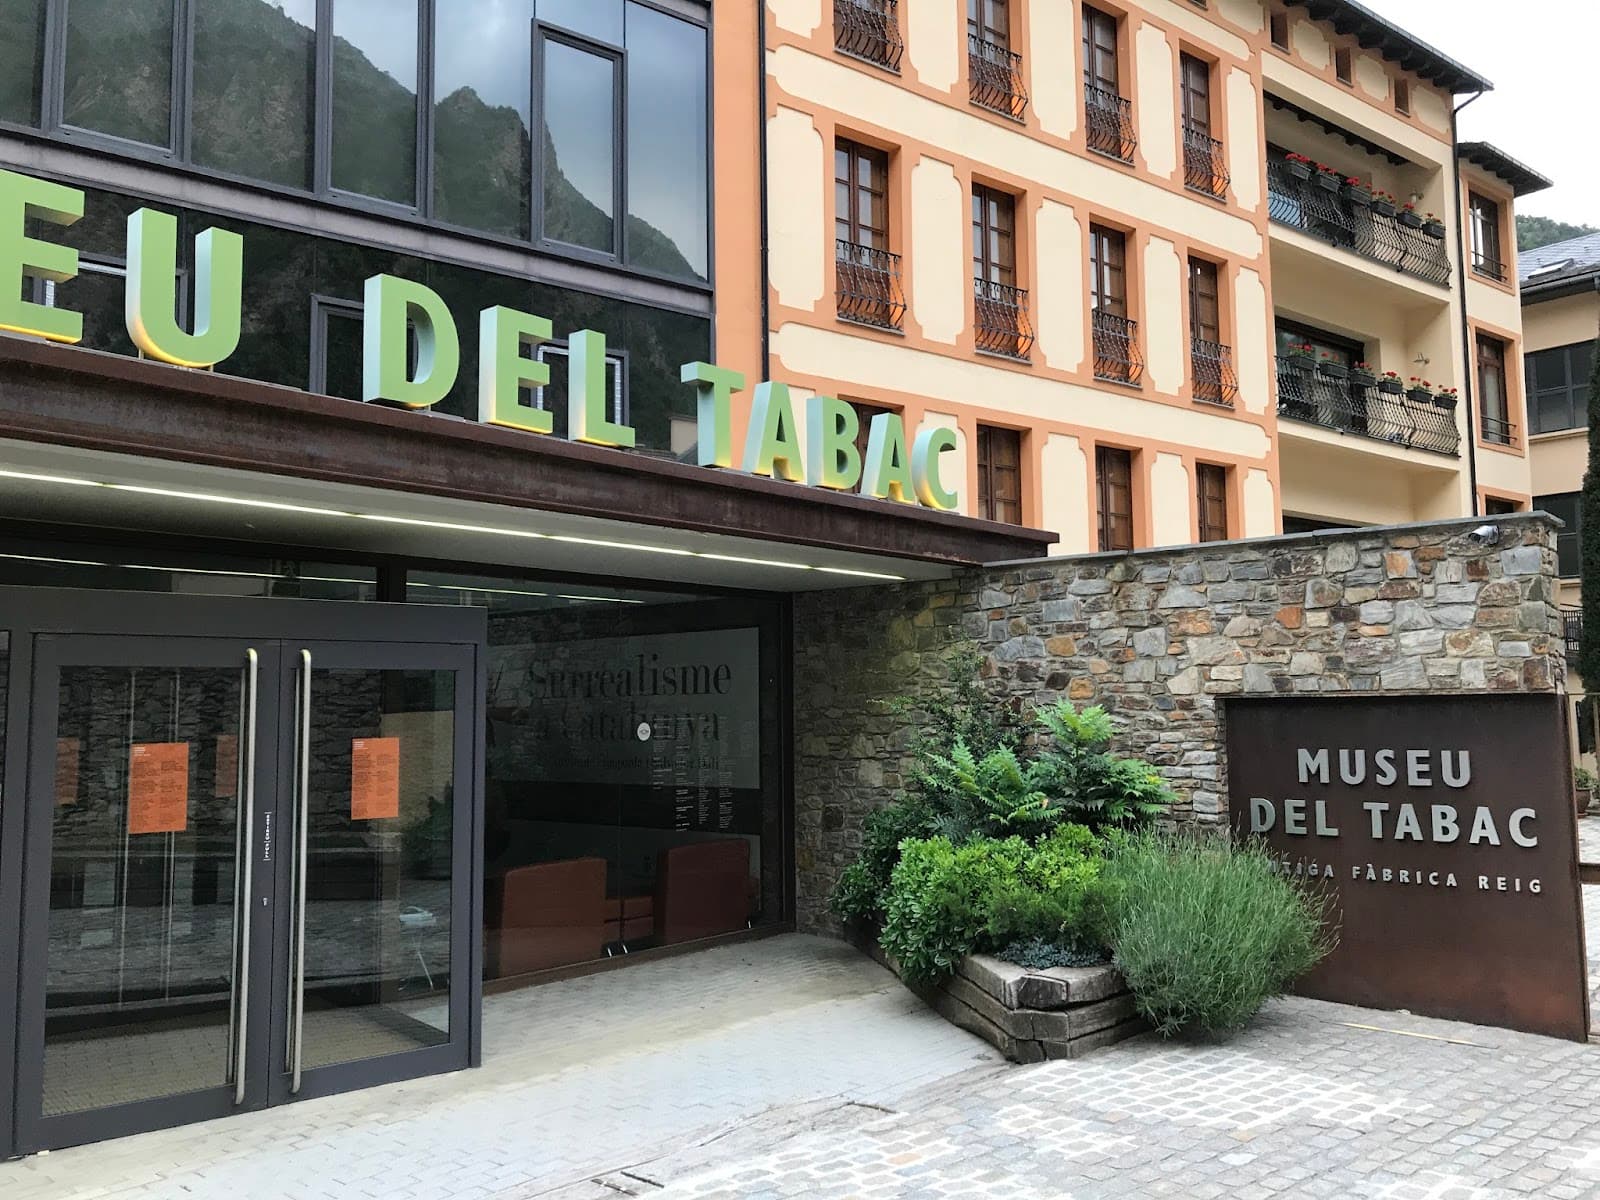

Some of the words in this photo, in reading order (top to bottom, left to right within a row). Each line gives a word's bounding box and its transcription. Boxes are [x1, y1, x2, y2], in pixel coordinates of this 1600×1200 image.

[363, 273, 636, 449] DEL
[681, 361, 958, 513] TABAC
[1297, 748, 1472, 788] MUSEU
[1249, 797, 1340, 837] DEL
[1363, 802, 1538, 848] TABAC
[1352, 863, 1458, 888] FÀBRICA
[1478, 876, 1542, 894] REIG
